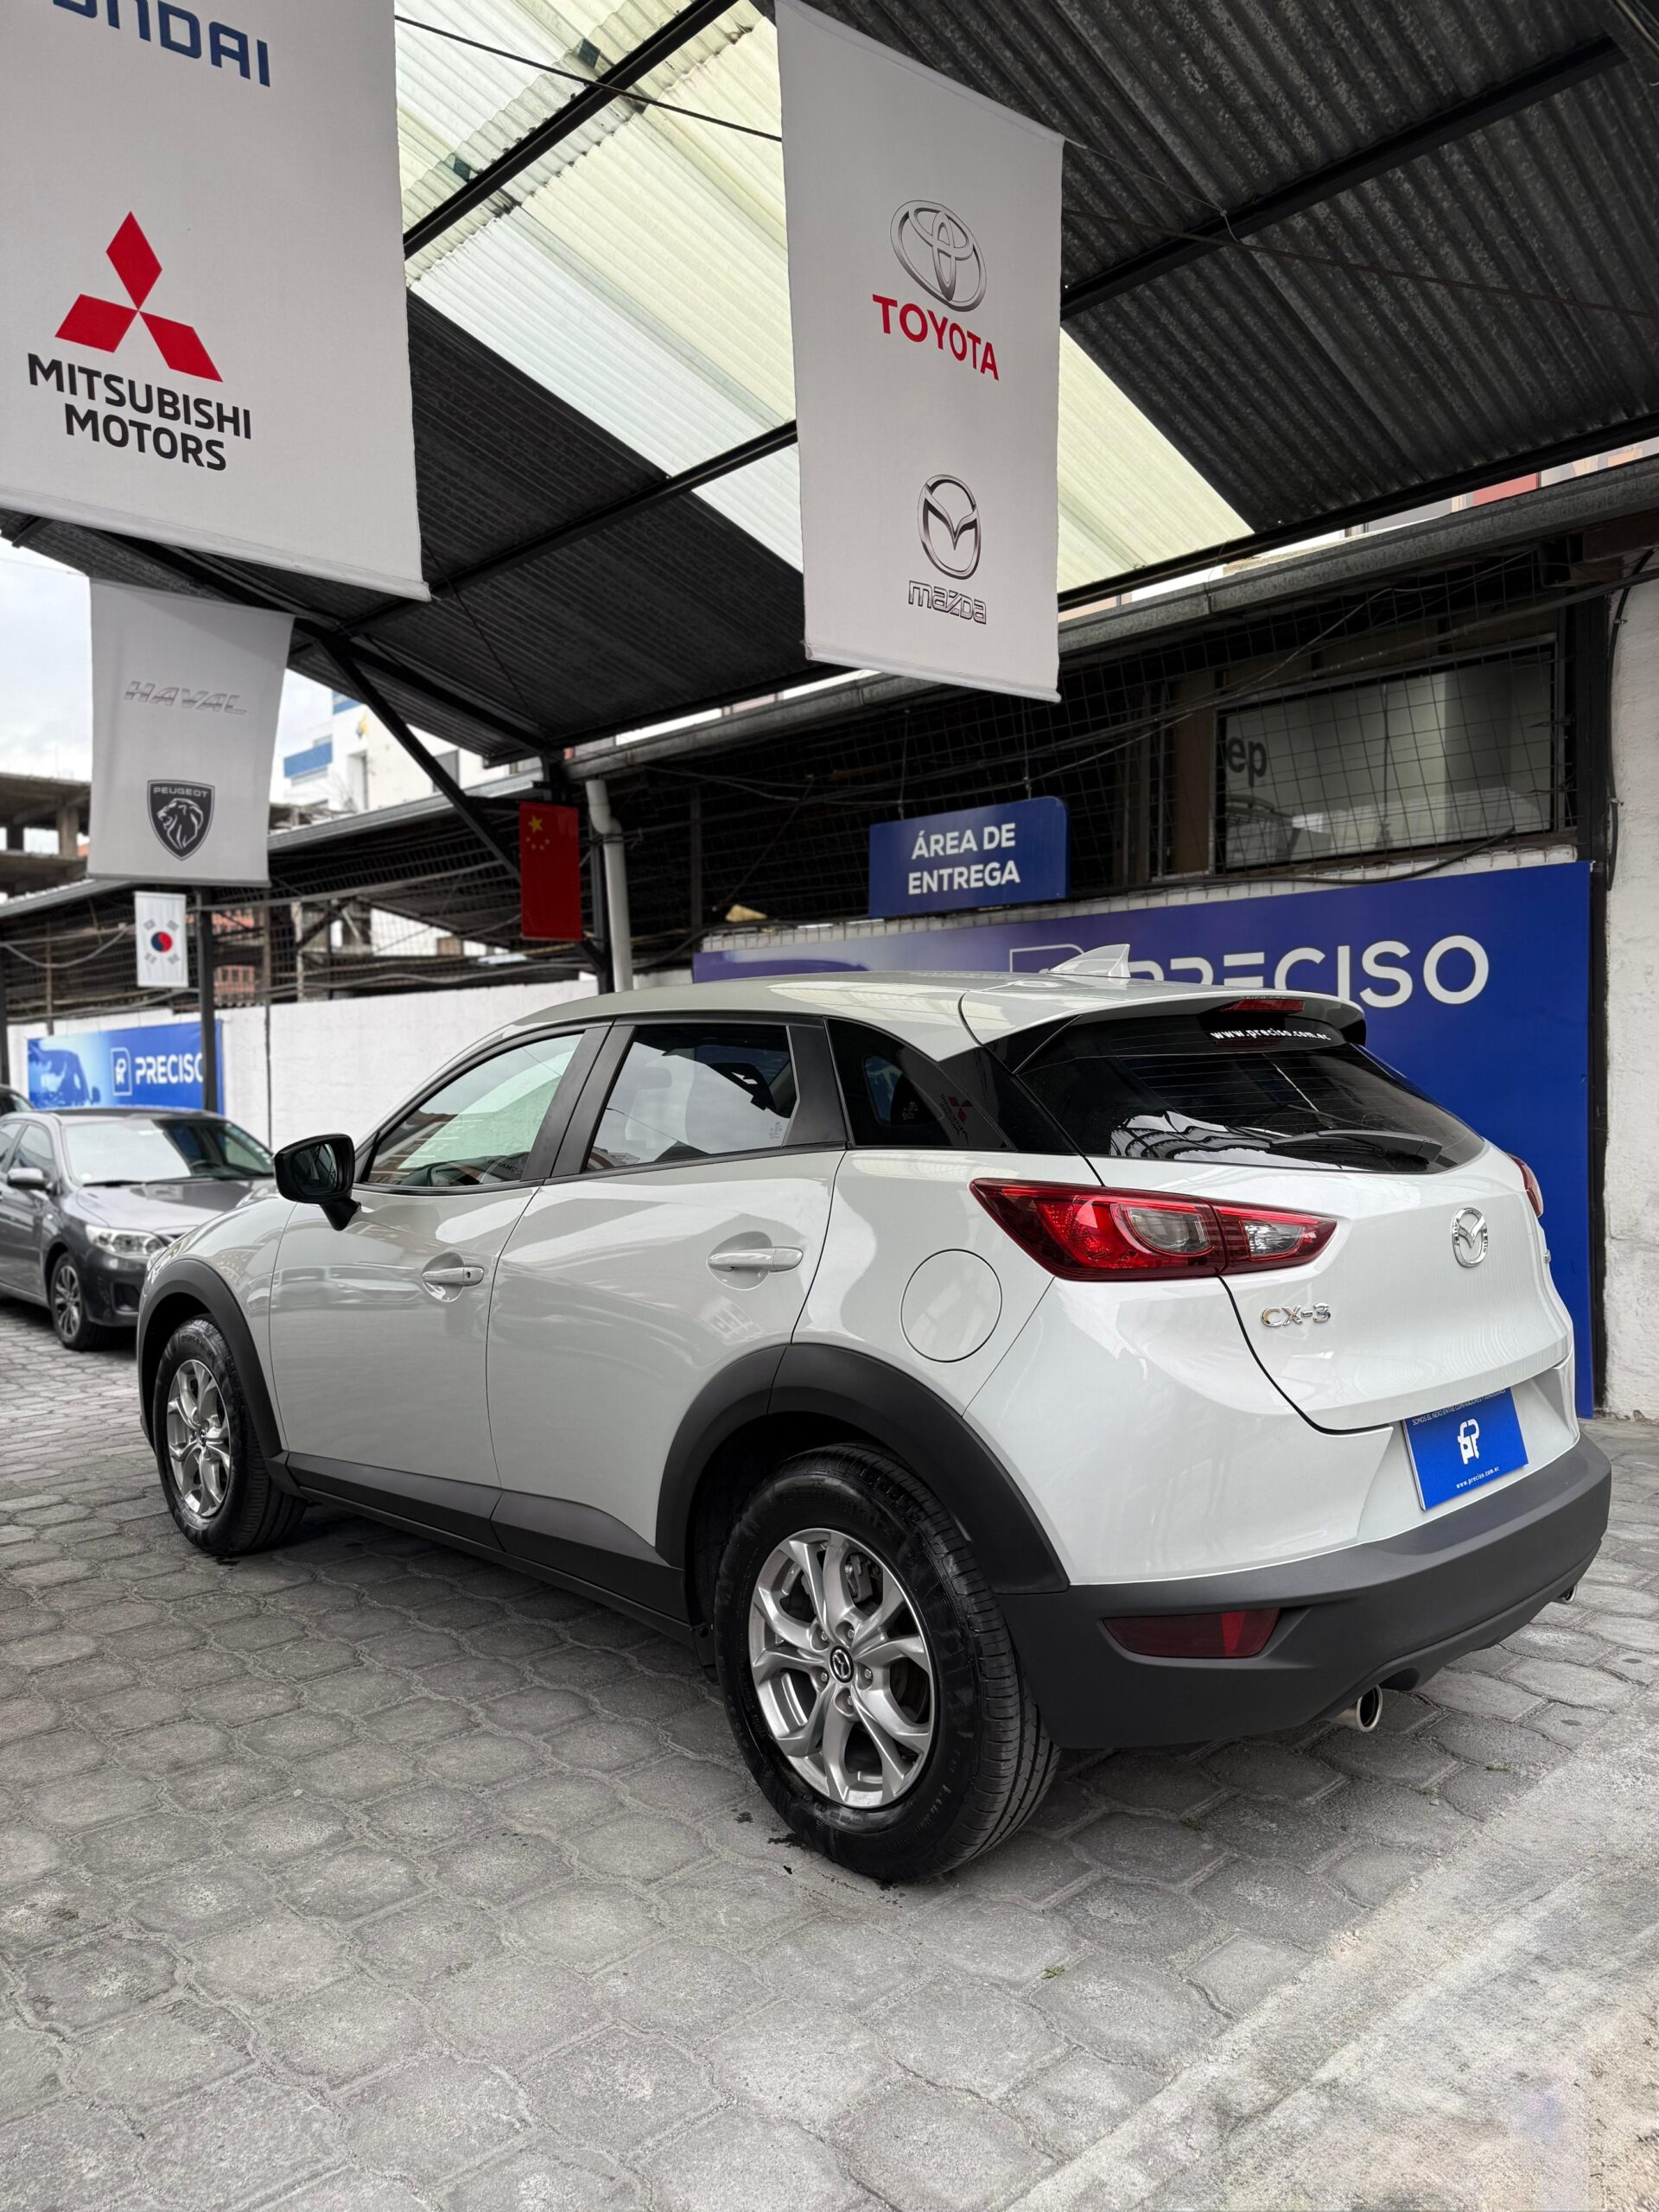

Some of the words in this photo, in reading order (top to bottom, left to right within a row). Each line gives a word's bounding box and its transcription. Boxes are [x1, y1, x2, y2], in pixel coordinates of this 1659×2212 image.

[872, 294, 1000, 380] TOYOTA
[28, 353, 251, 440] MITSUBISHI
[65, 404, 226, 472] MOTORS
[908, 580, 987, 626] mazda
[124, 680, 247, 715] HAVAL
[153, 787, 207, 798] PEUGEOT
[912, 830, 978, 860] ÁREA
[983, 823, 1016, 850] DE
[908, 860, 1020, 895] ENTREGA
[1211, 1027, 1332, 1041] www.preciso.com.ec
[1260, 1302, 1332, 1328] CX-3
